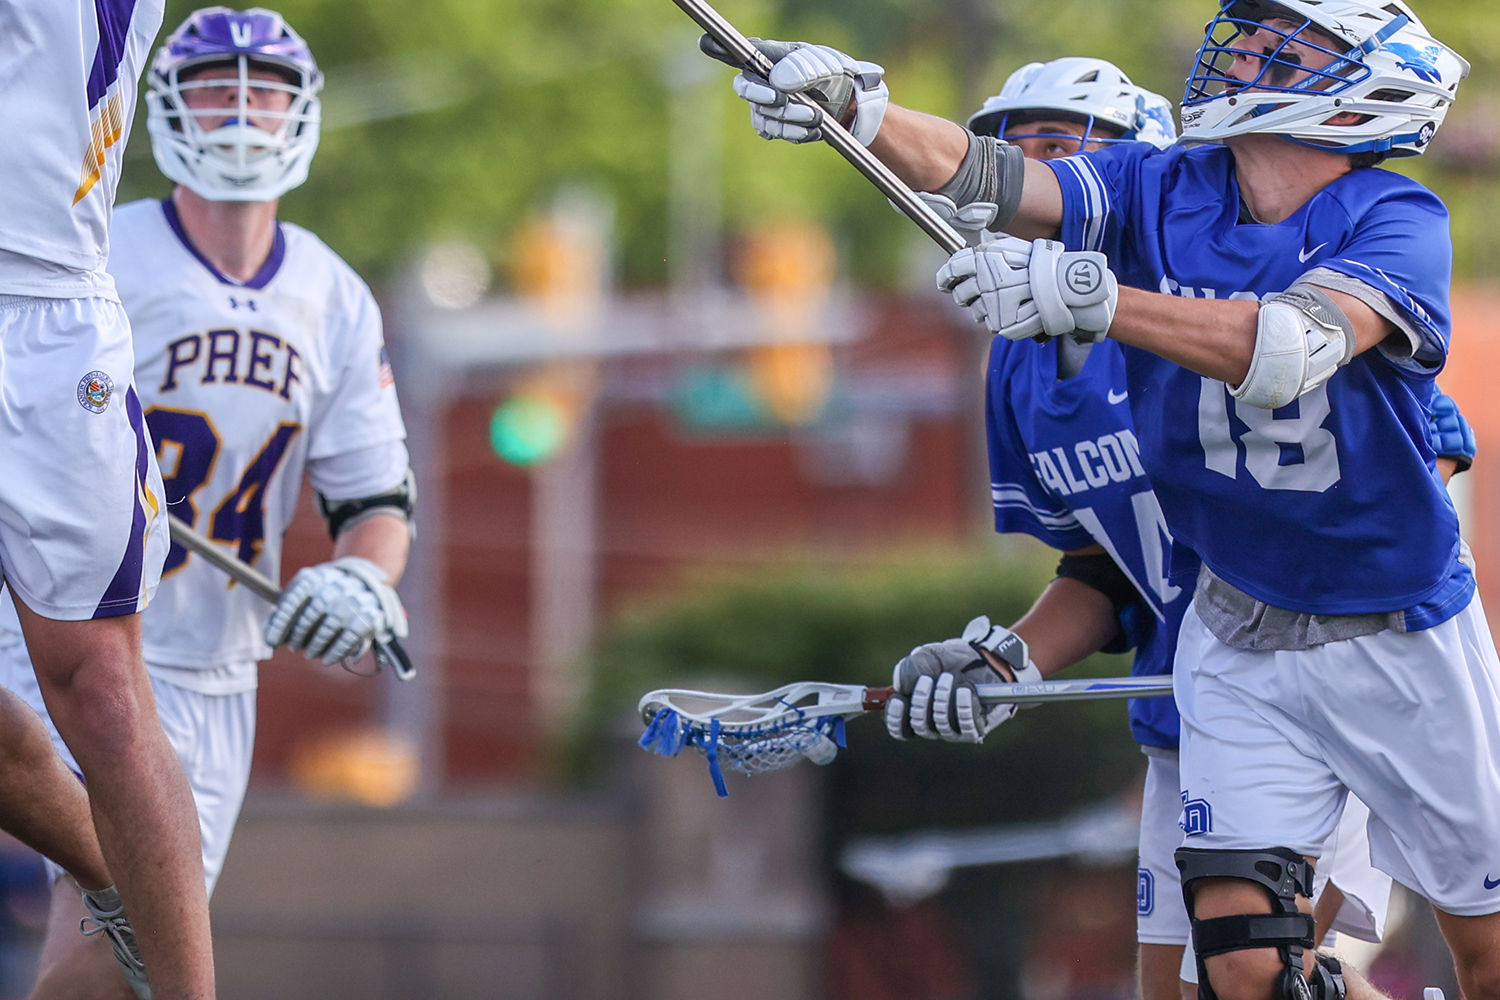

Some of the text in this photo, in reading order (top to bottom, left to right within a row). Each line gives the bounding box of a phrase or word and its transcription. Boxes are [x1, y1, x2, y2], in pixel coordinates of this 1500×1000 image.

[159, 327, 302, 402] PREP
[1198, 376, 1342, 493] 18
[143, 404, 303, 590] 34
